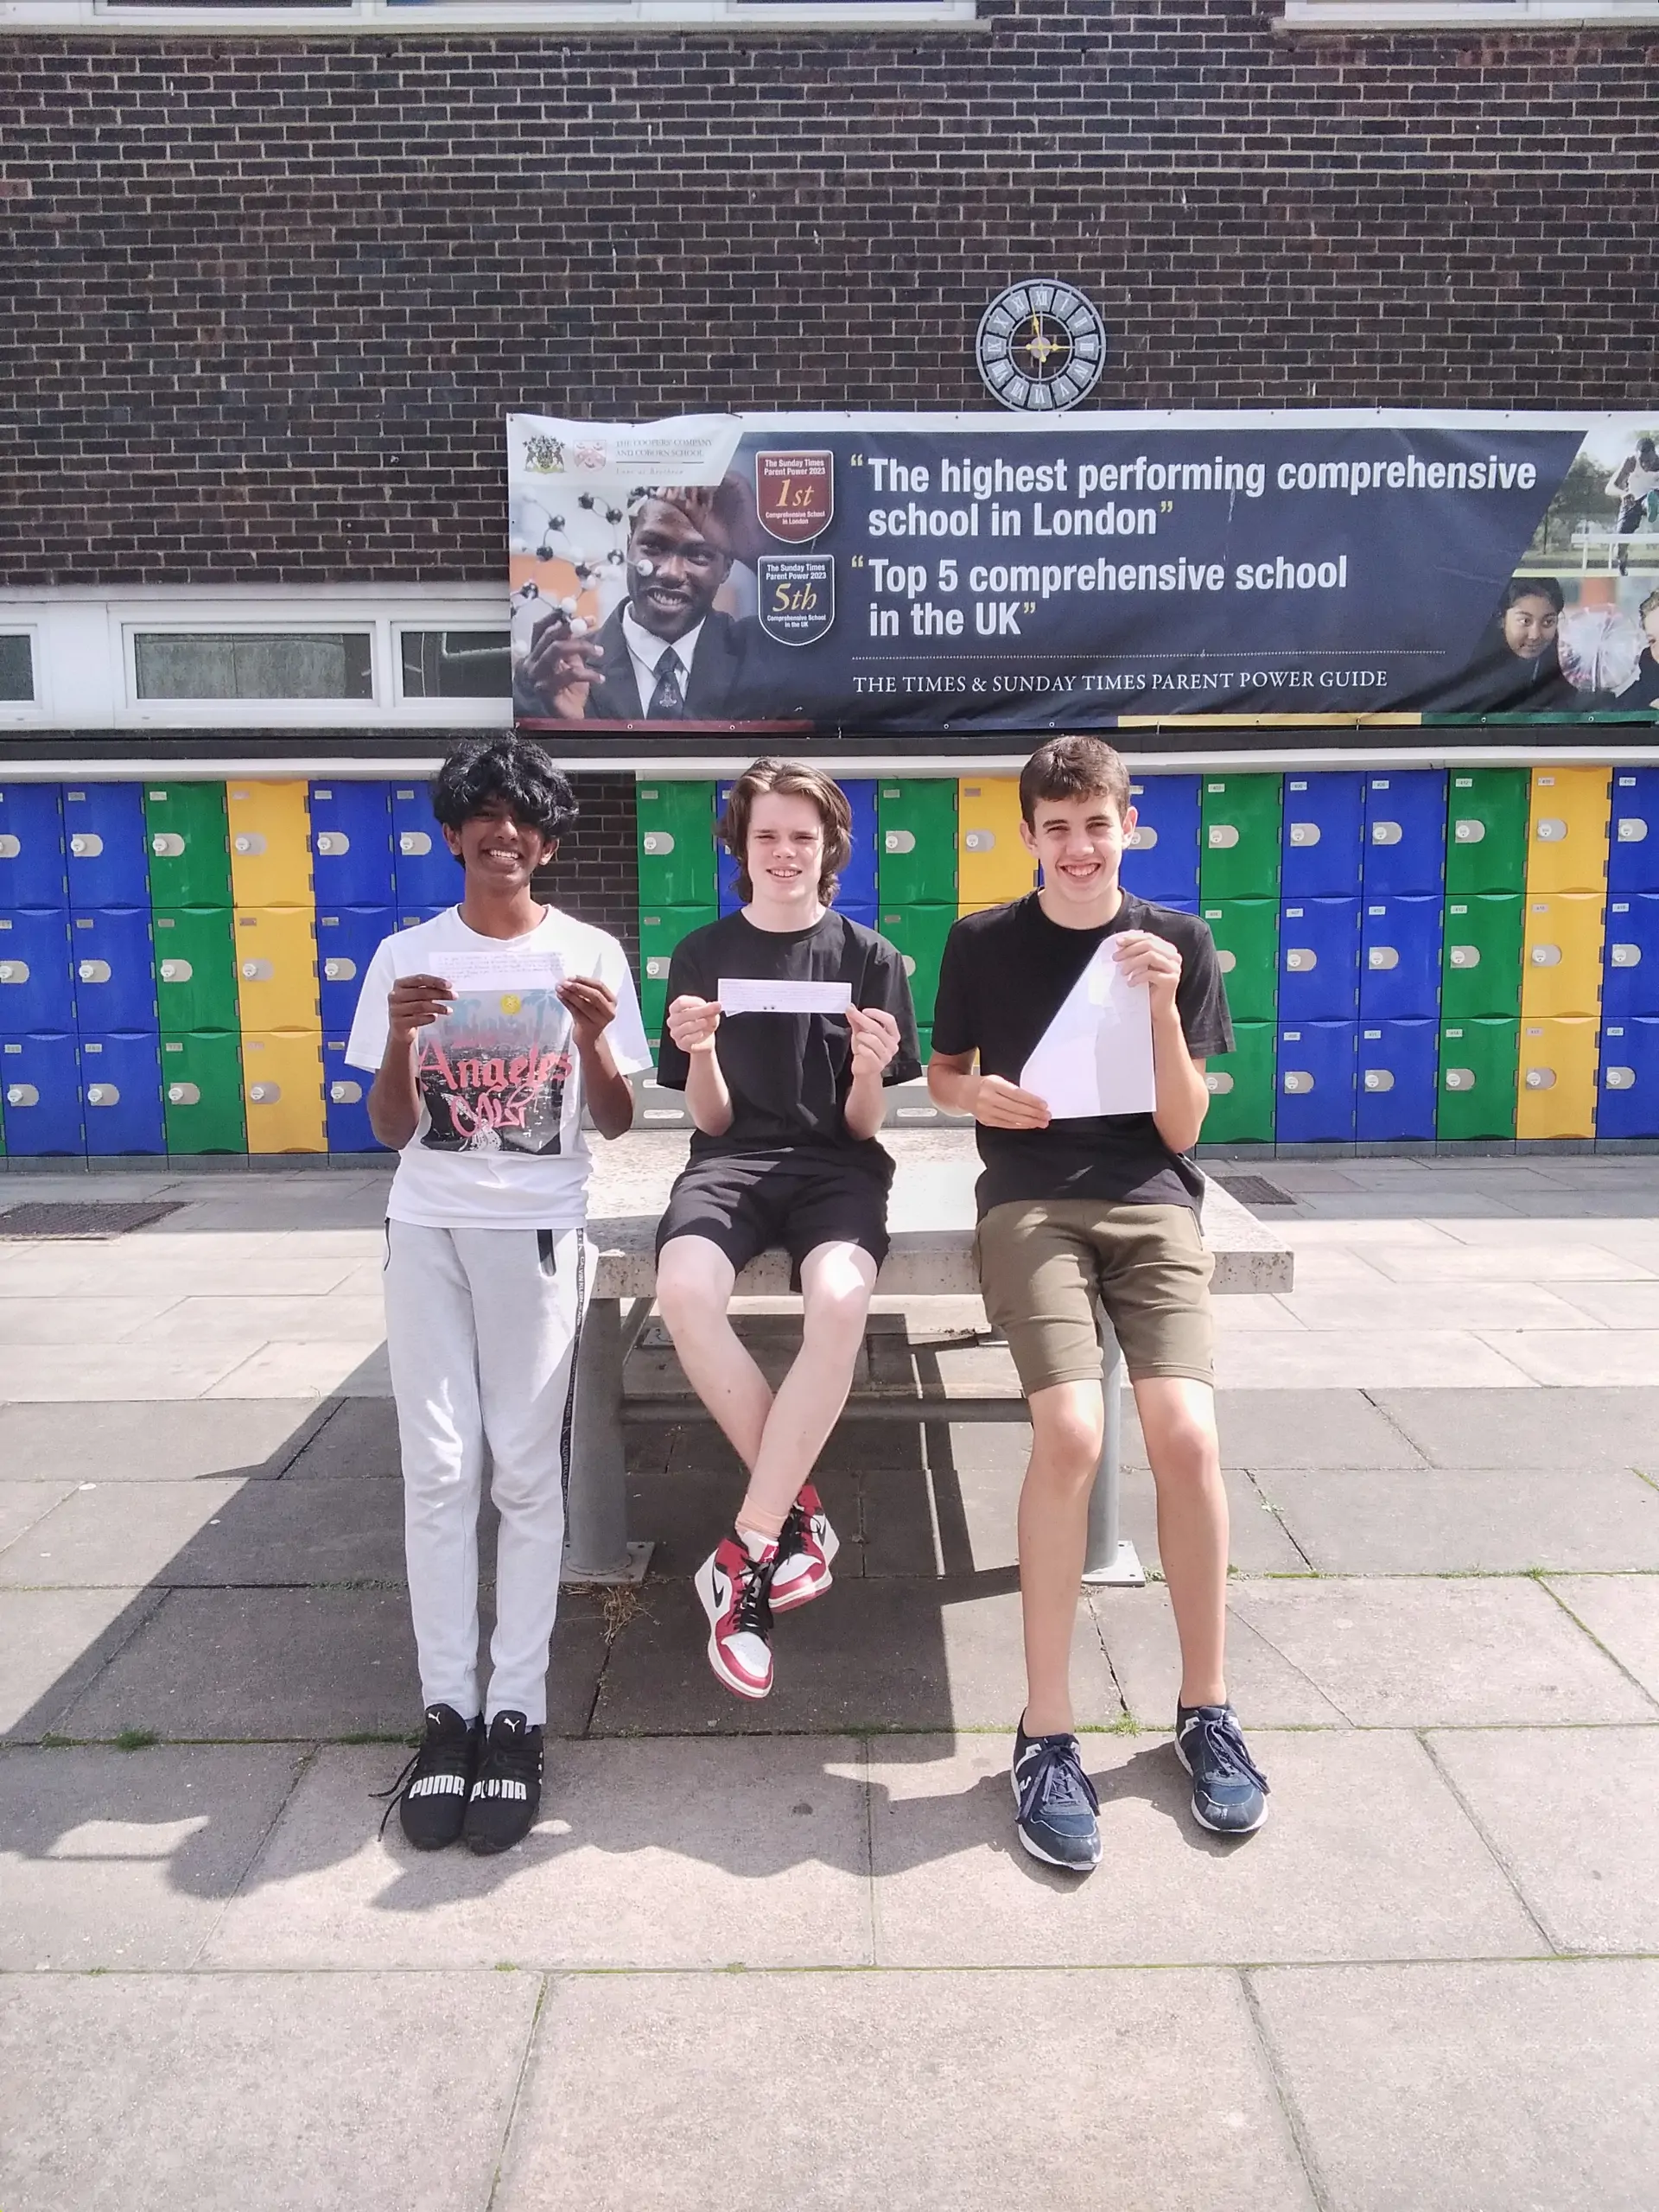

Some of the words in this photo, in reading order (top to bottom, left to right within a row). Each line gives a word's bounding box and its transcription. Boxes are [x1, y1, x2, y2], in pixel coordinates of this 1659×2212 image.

[1012, 296, 1026, 313] XI
[1035, 290, 1047, 306] XII
[993, 315, 1008, 329] X
[1074, 316, 1088, 329] II
[988, 340, 1002, 352] IX
[1079, 343, 1094, 352] III
[1073, 363, 1089, 379] IV
[1035, 389, 1046, 404] VI
[1059, 383, 1070, 397] V
[673, 438, 714, 447] COMPANY
[765, 459, 778, 467] The
[779, 459, 804, 468] Sunday
[804, 458, 824, 467] Times
[764, 467, 786, 476] Parent
[941, 458, 1068, 500] highest
[1078, 455, 1266, 499] performing
[1277, 454, 1537, 496] comprehensive
[775, 478, 815, 507] 1st
[868, 502, 979, 537] school
[991, 502, 1021, 537] in
[780, 563, 805, 573] Sunday
[766, 572, 788, 581] Parent
[938, 558, 958, 592] 5
[969, 556, 1225, 599] comprehensive
[1236, 554, 1347, 591] school
[772, 582, 817, 612] 5th
[869, 602, 899, 637] in
[910, 602, 964, 636] the
[853, 676, 897, 693] THE
[902, 676, 966, 693] TIMES
[971, 677, 988, 692] &
[992, 676, 1077, 692] SUNDAY
[1081, 673, 1146, 691] TIMES
[1151, 672, 1235, 690] PARENT
[1239, 671, 1315, 689] POWER
[1319, 671, 1388, 688] GUIDE
[417, 1037, 574, 1093] Angeles
[409, 1774, 465, 1800] PUMA
